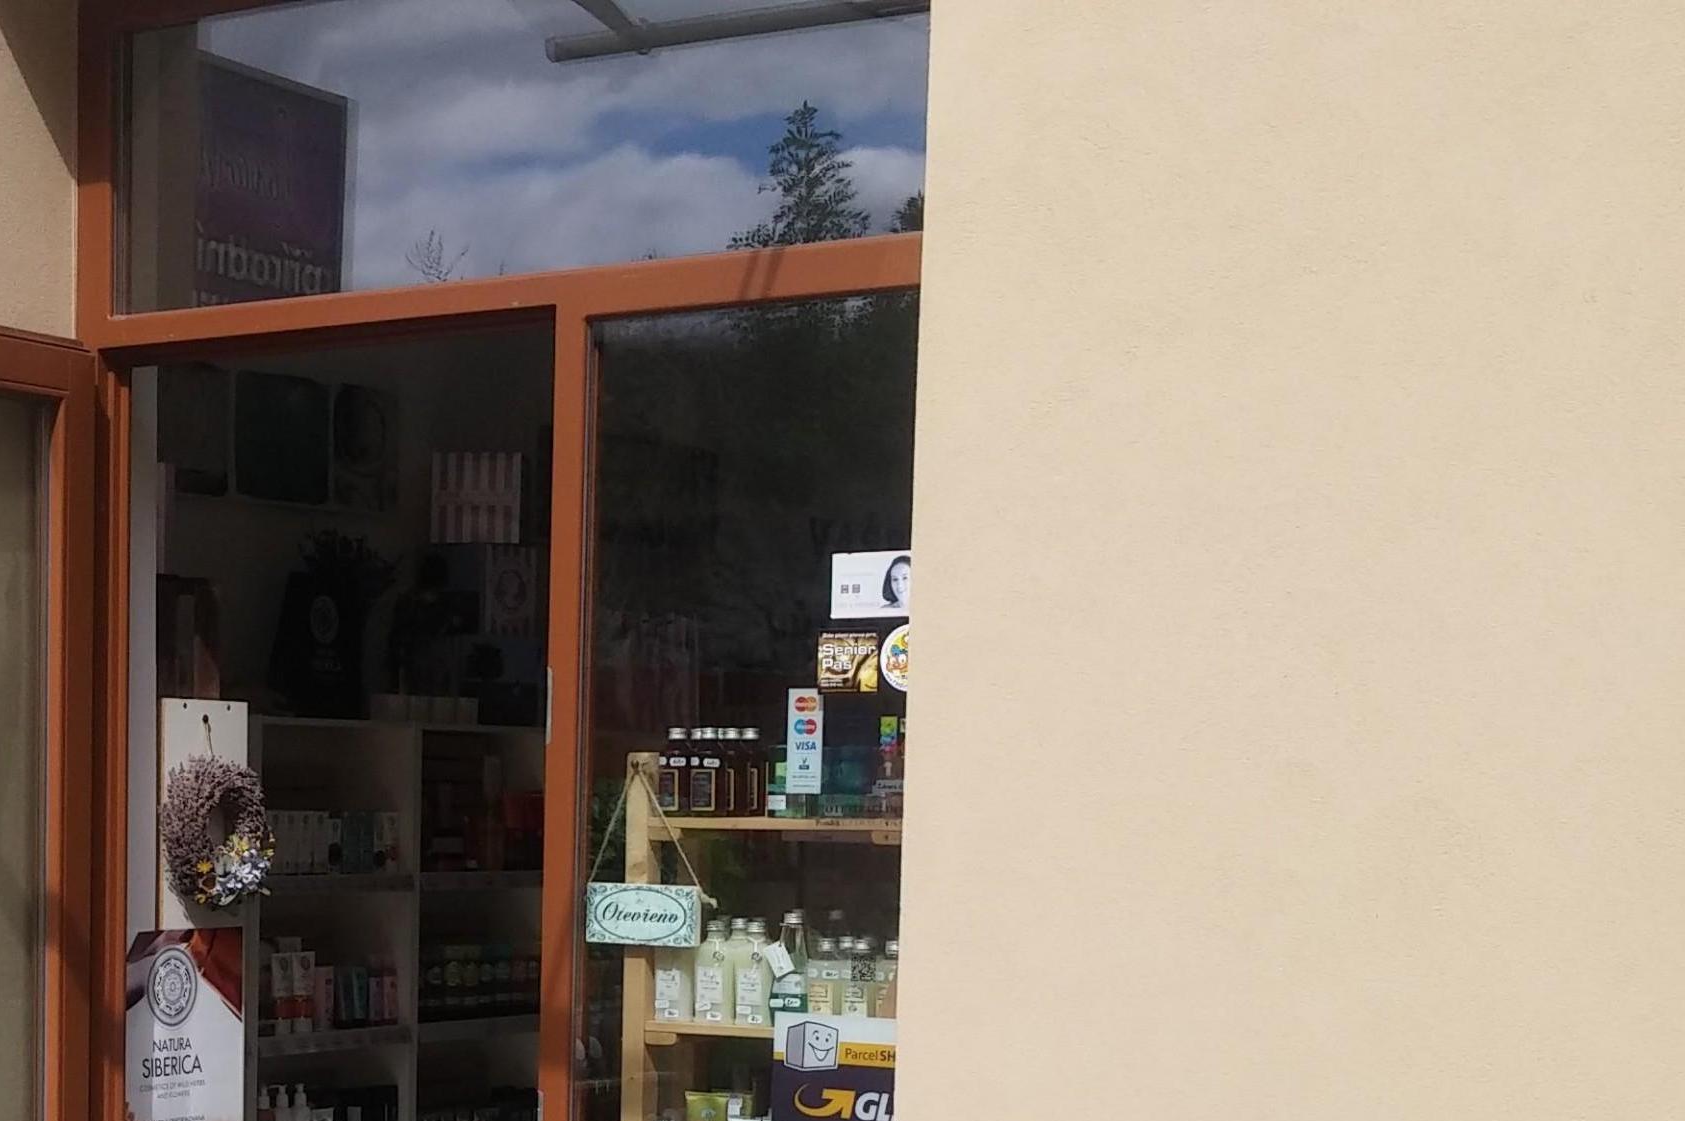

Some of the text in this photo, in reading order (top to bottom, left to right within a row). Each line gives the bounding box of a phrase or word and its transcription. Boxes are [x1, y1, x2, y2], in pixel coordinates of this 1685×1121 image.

[822, 643, 876, 656] Senior
[822, 658, 852, 671] Pas
[795, 741, 817, 751] VISA
[152, 1037, 192, 1052] NATURA
[142, 1054, 203, 1079] SIBERICA
